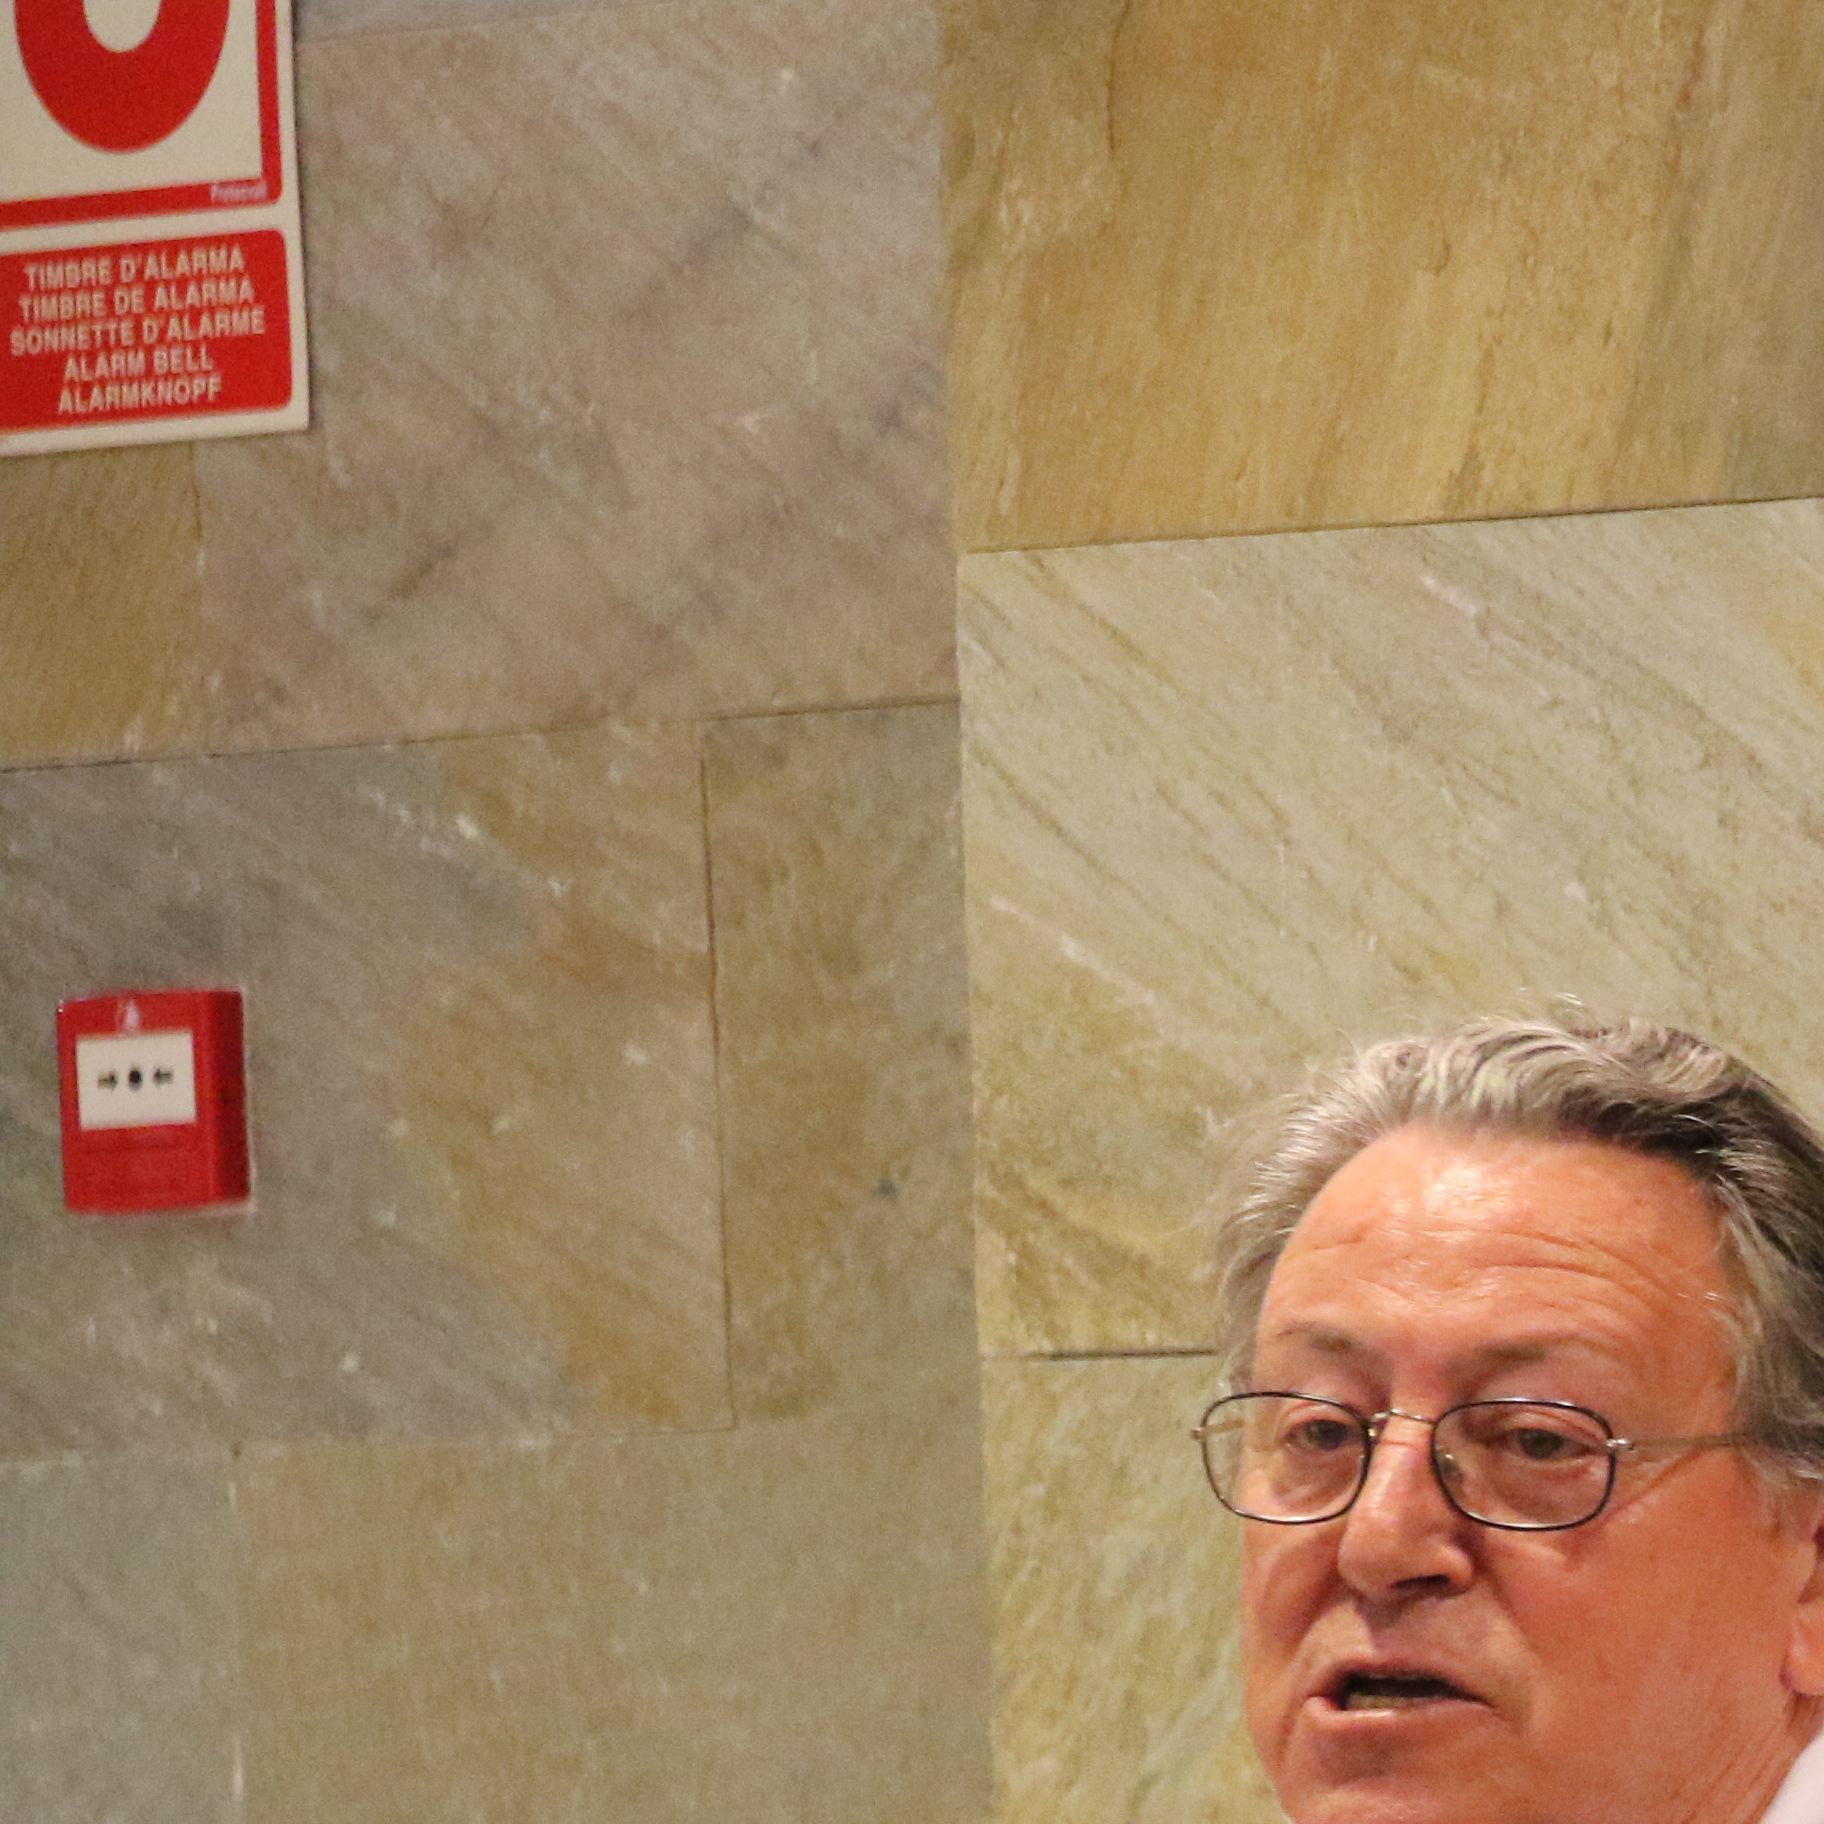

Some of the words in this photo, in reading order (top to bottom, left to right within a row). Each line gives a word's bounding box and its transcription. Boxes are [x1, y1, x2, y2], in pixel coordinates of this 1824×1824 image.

[25, 258, 112, 289] TIMBRE
[120, 246, 245, 282] D'ALARMA
[20, 290, 105, 322] TIMBRE
[115, 286, 145, 315] DE
[154, 277, 254, 311] ALARMA
[10, 321, 135, 355] SONNETTE
[142, 307, 265, 344] D'ALARME
[65, 350, 145, 382] ALARM
[152, 342, 214, 375] BELL
[58, 373, 221, 414] ALARMKNOPF
